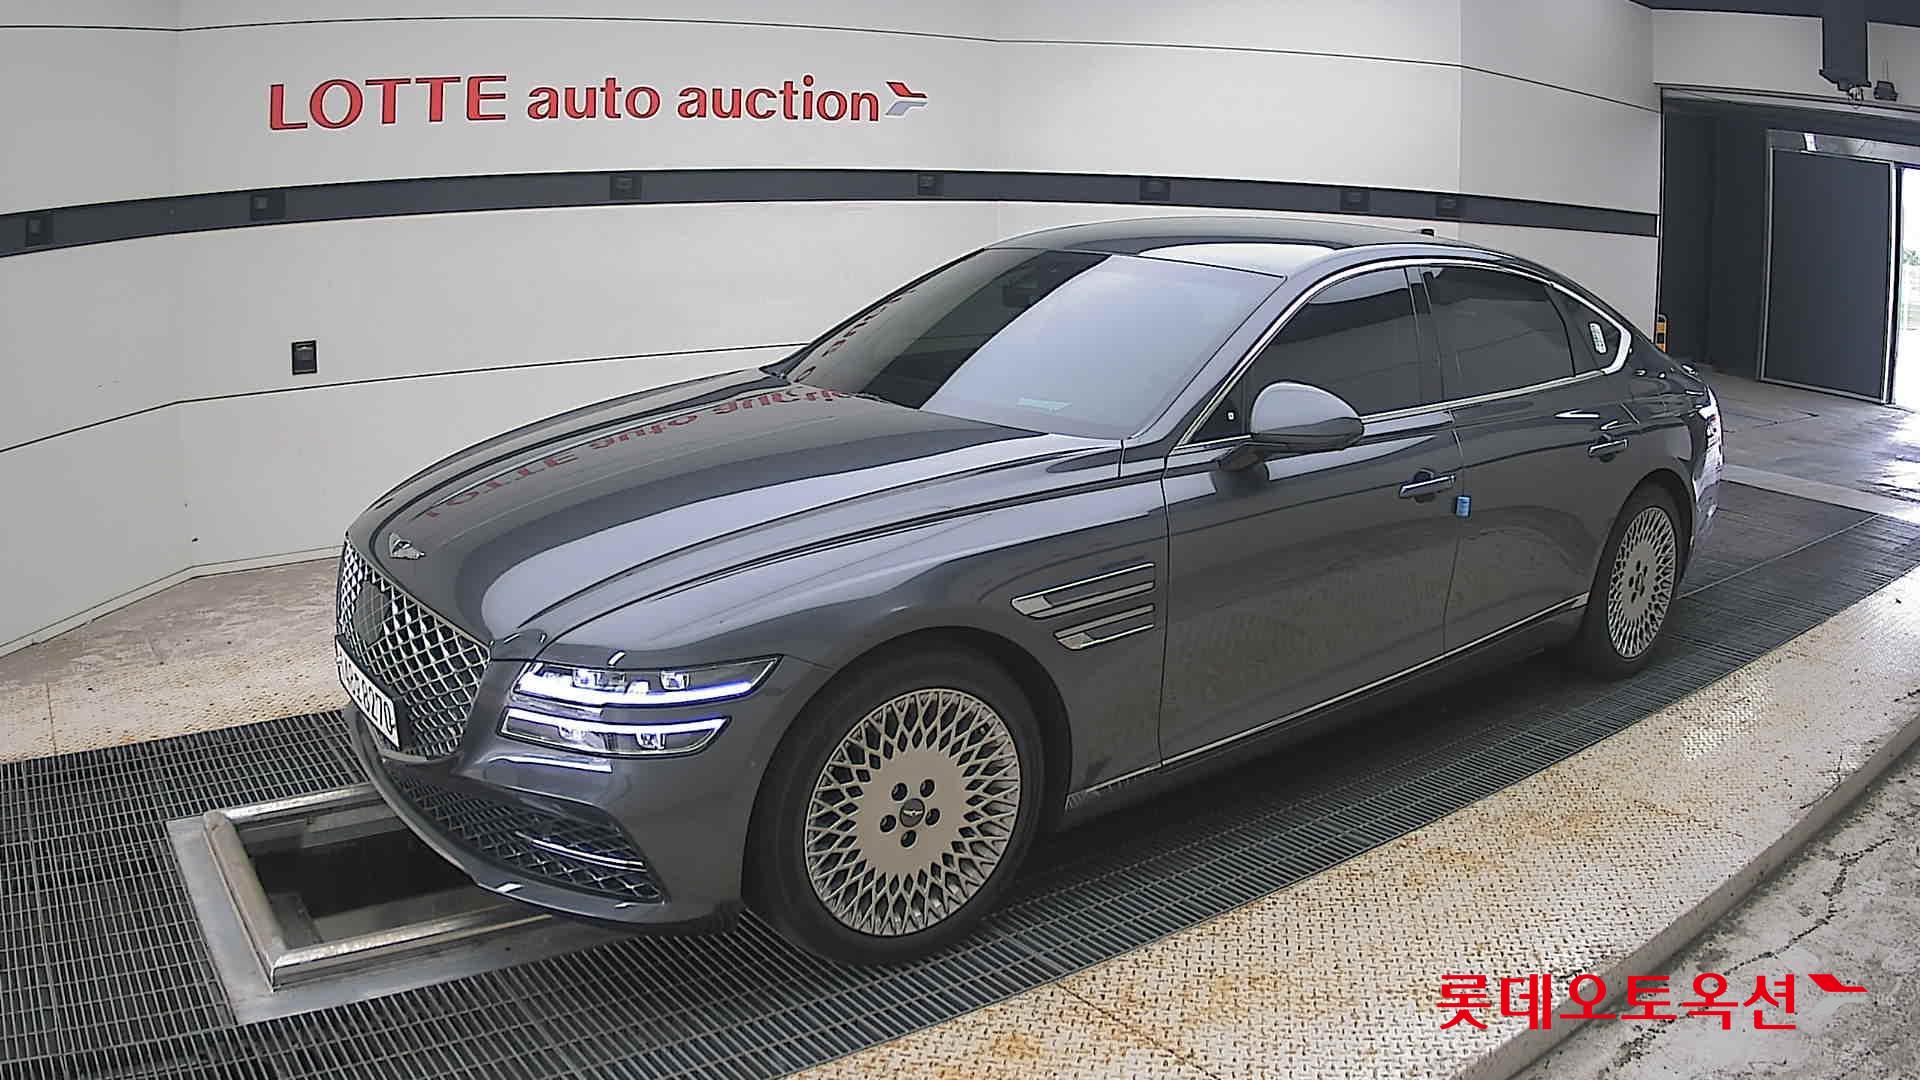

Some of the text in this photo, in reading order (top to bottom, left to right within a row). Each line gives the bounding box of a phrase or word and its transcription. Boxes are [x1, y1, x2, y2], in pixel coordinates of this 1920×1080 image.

[269, 74, 880, 131] LOTTE auto auction
